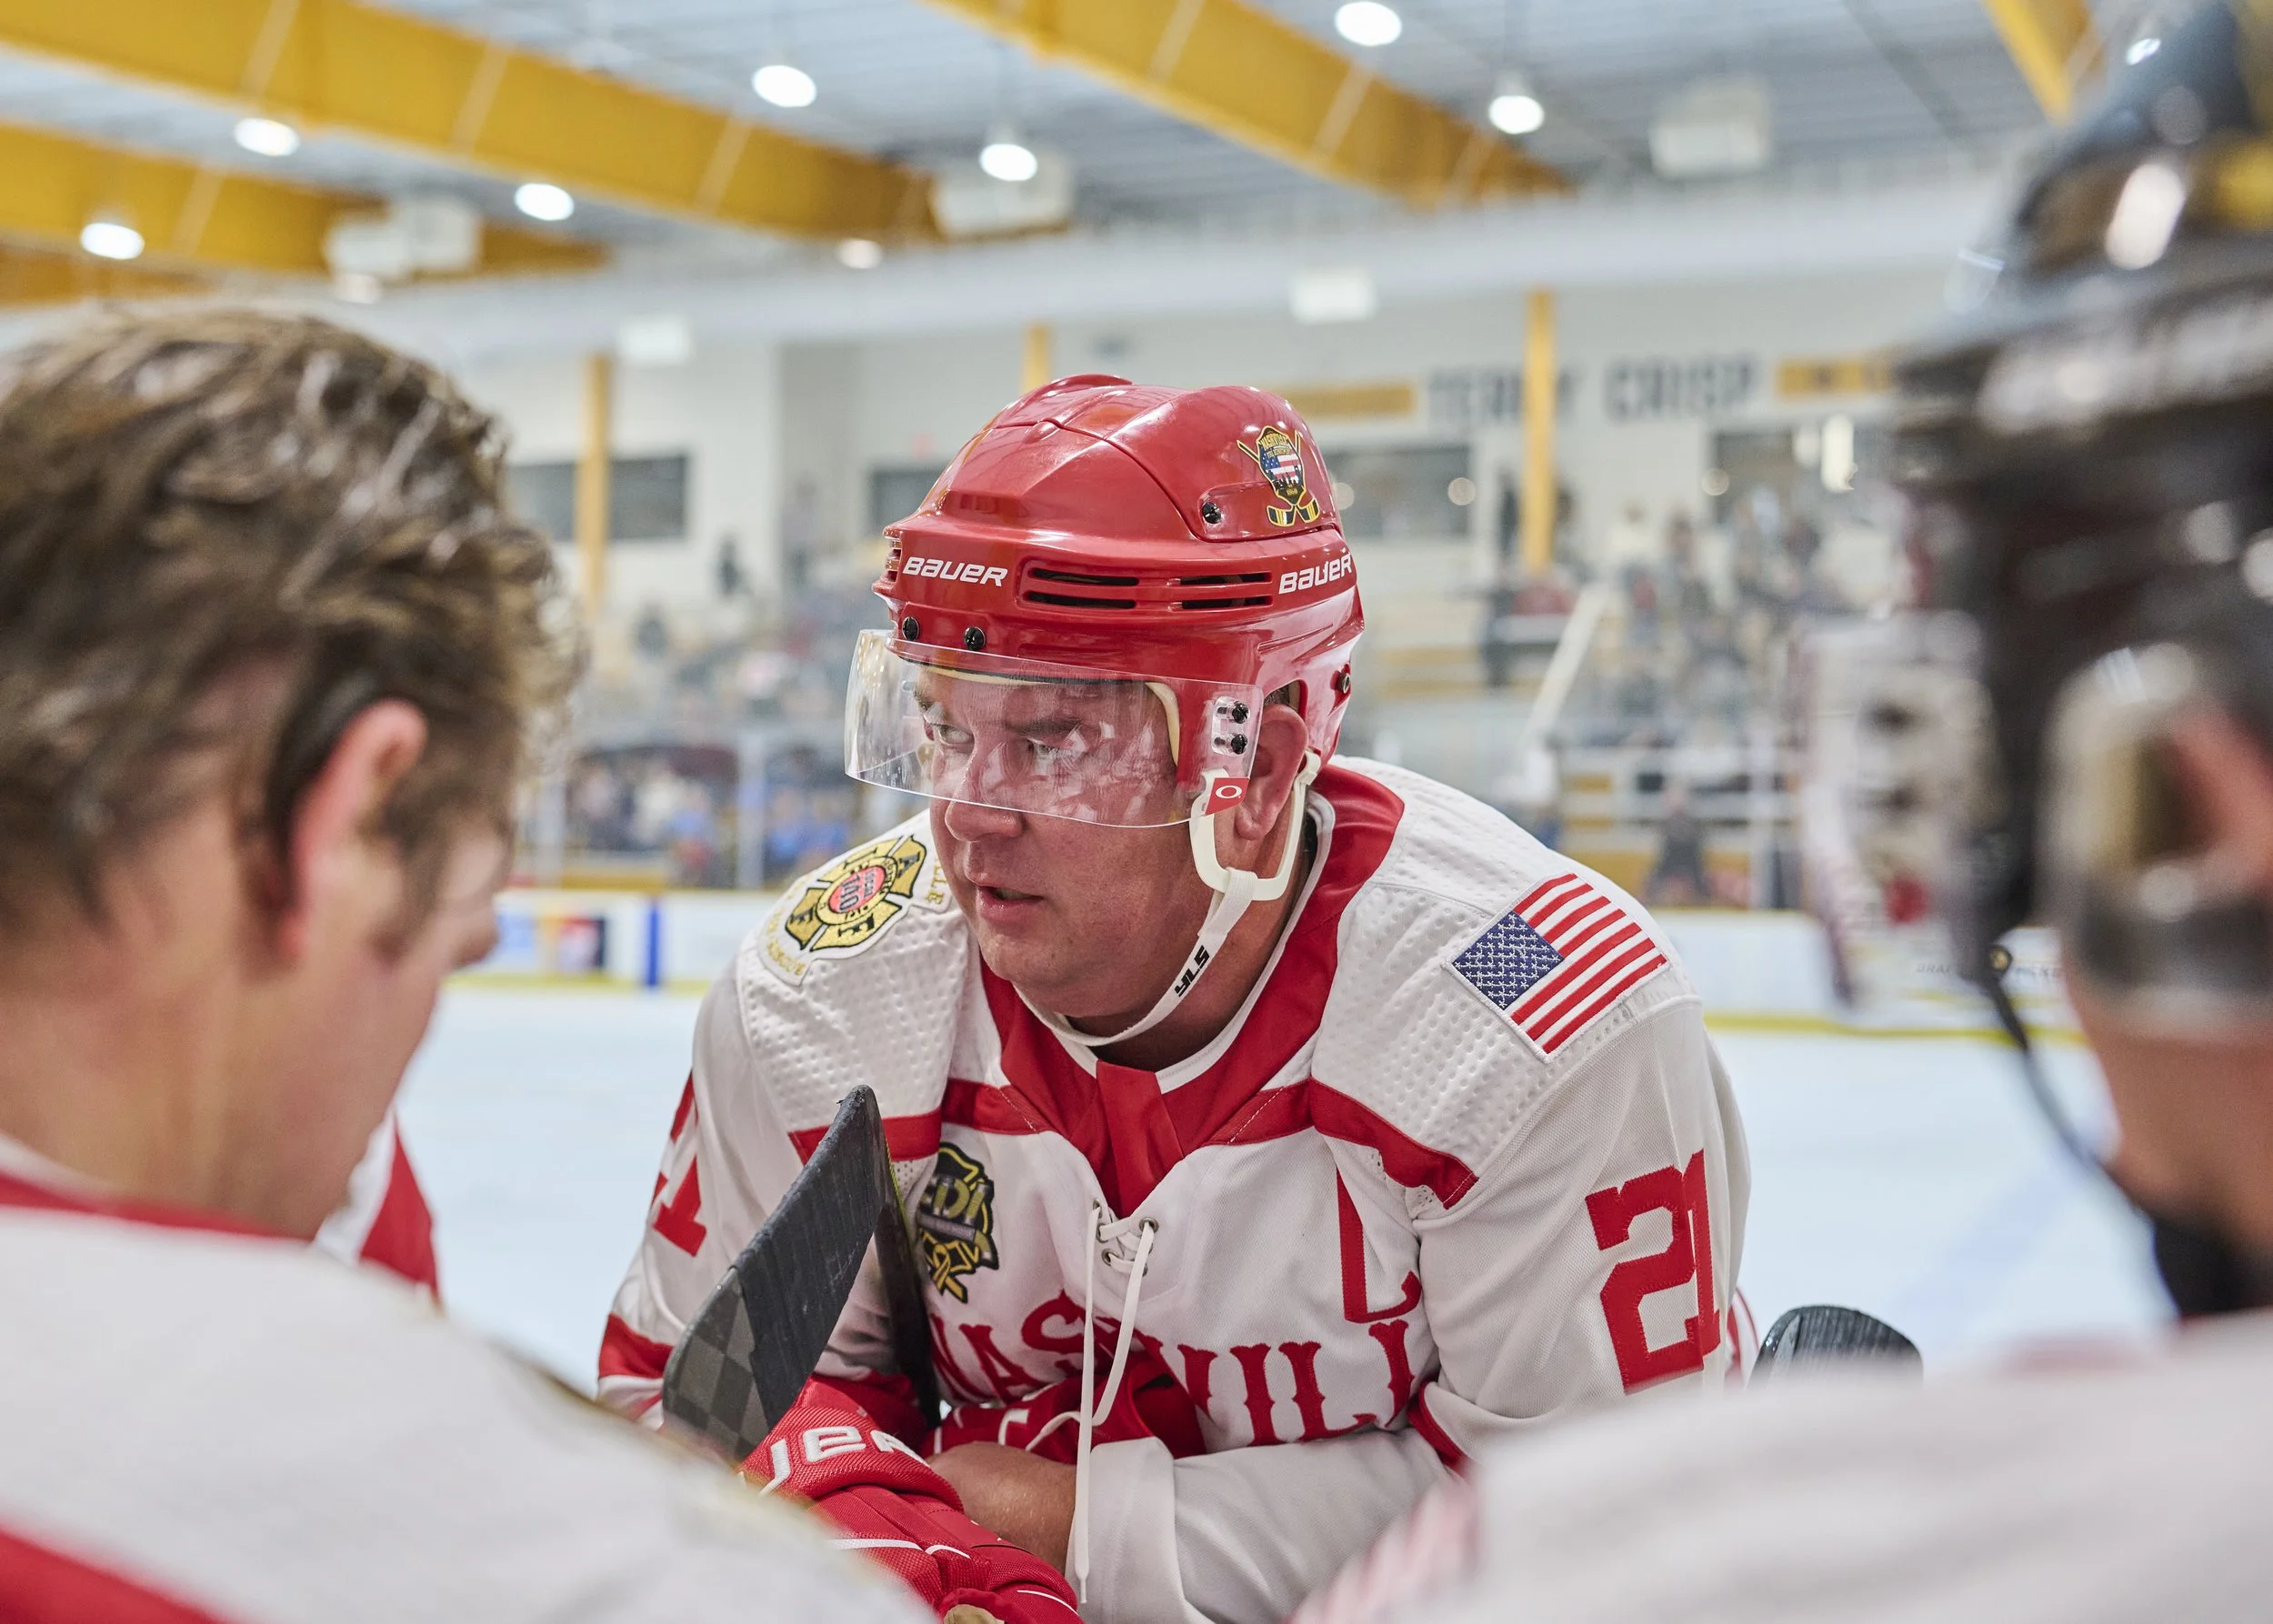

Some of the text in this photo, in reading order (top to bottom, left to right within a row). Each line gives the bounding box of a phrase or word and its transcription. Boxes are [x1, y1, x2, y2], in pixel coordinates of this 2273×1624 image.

[1427, 362, 1584, 424] TERY
[902, 556, 1008, 587] BAUER
[1277, 551, 1353, 595] BAUER
[1584, 1148, 1722, 1397] 21
